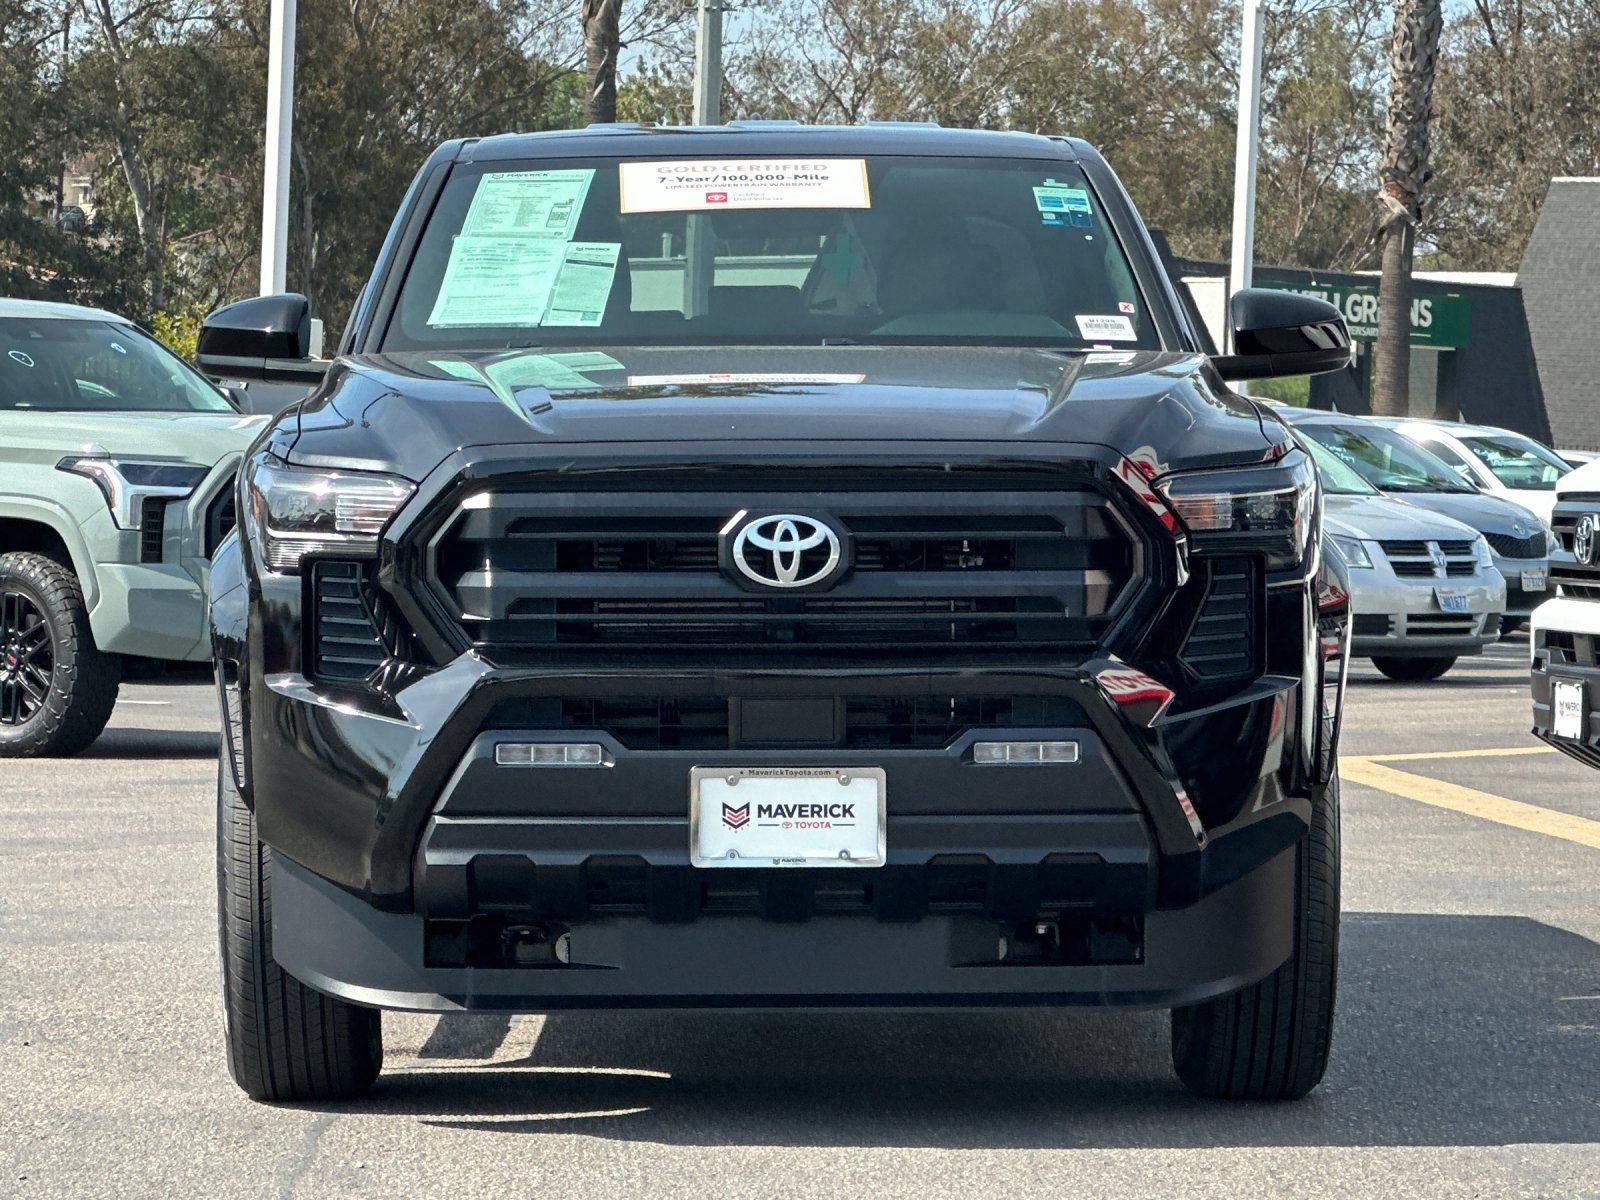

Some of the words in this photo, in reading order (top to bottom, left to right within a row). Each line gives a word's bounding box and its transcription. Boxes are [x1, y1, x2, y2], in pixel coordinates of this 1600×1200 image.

[657, 165, 717, 174] GOLD
[721, 164, 828, 172] CERTIFIED
[658, 173, 830, 184] 7-Year/100,000-Mile
[748, 769, 831, 777] MaverickToyota.com
[757, 803, 856, 819] MAVERICK
[794, 821, 832, 829] TOYOTA
